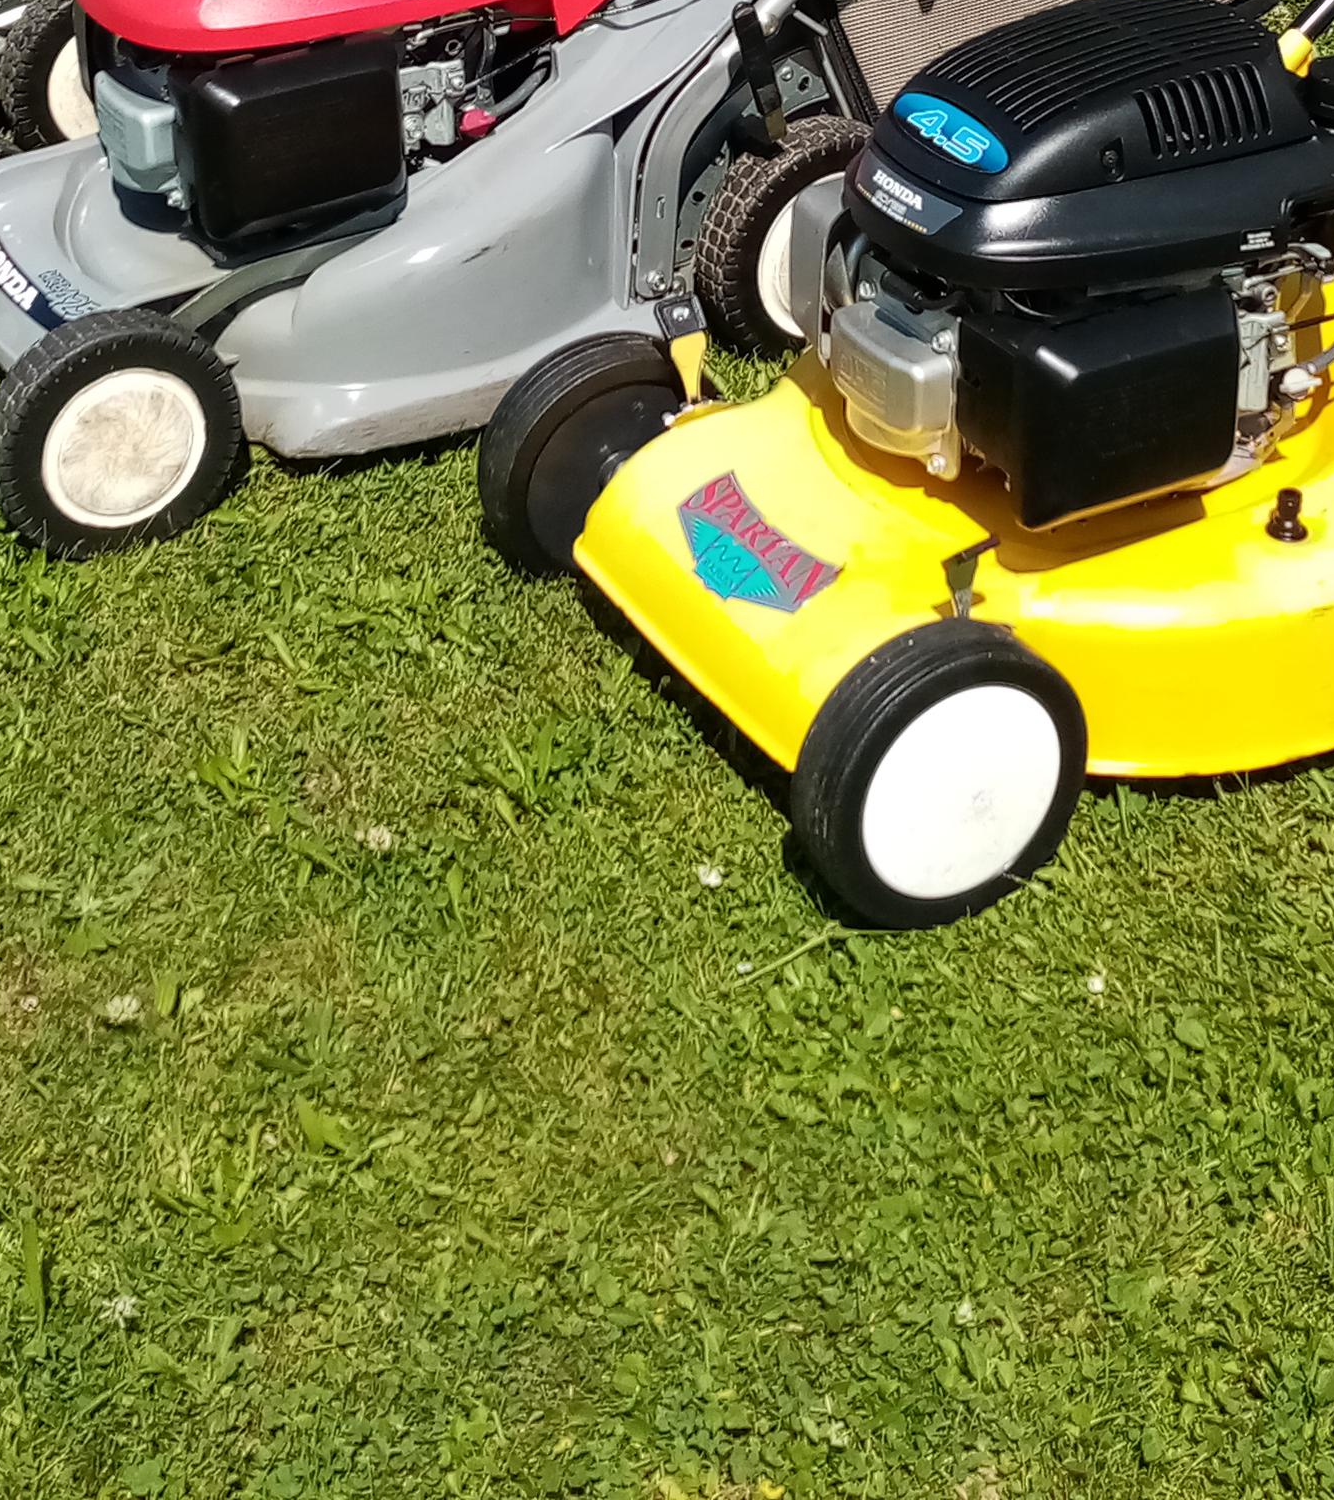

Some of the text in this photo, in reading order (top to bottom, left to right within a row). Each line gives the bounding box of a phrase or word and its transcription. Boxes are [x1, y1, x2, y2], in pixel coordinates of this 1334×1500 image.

[906, 109, 991, 164] 4.5
[871, 169, 924, 212] HONDA
[684, 474, 845, 605] SPARTAN
